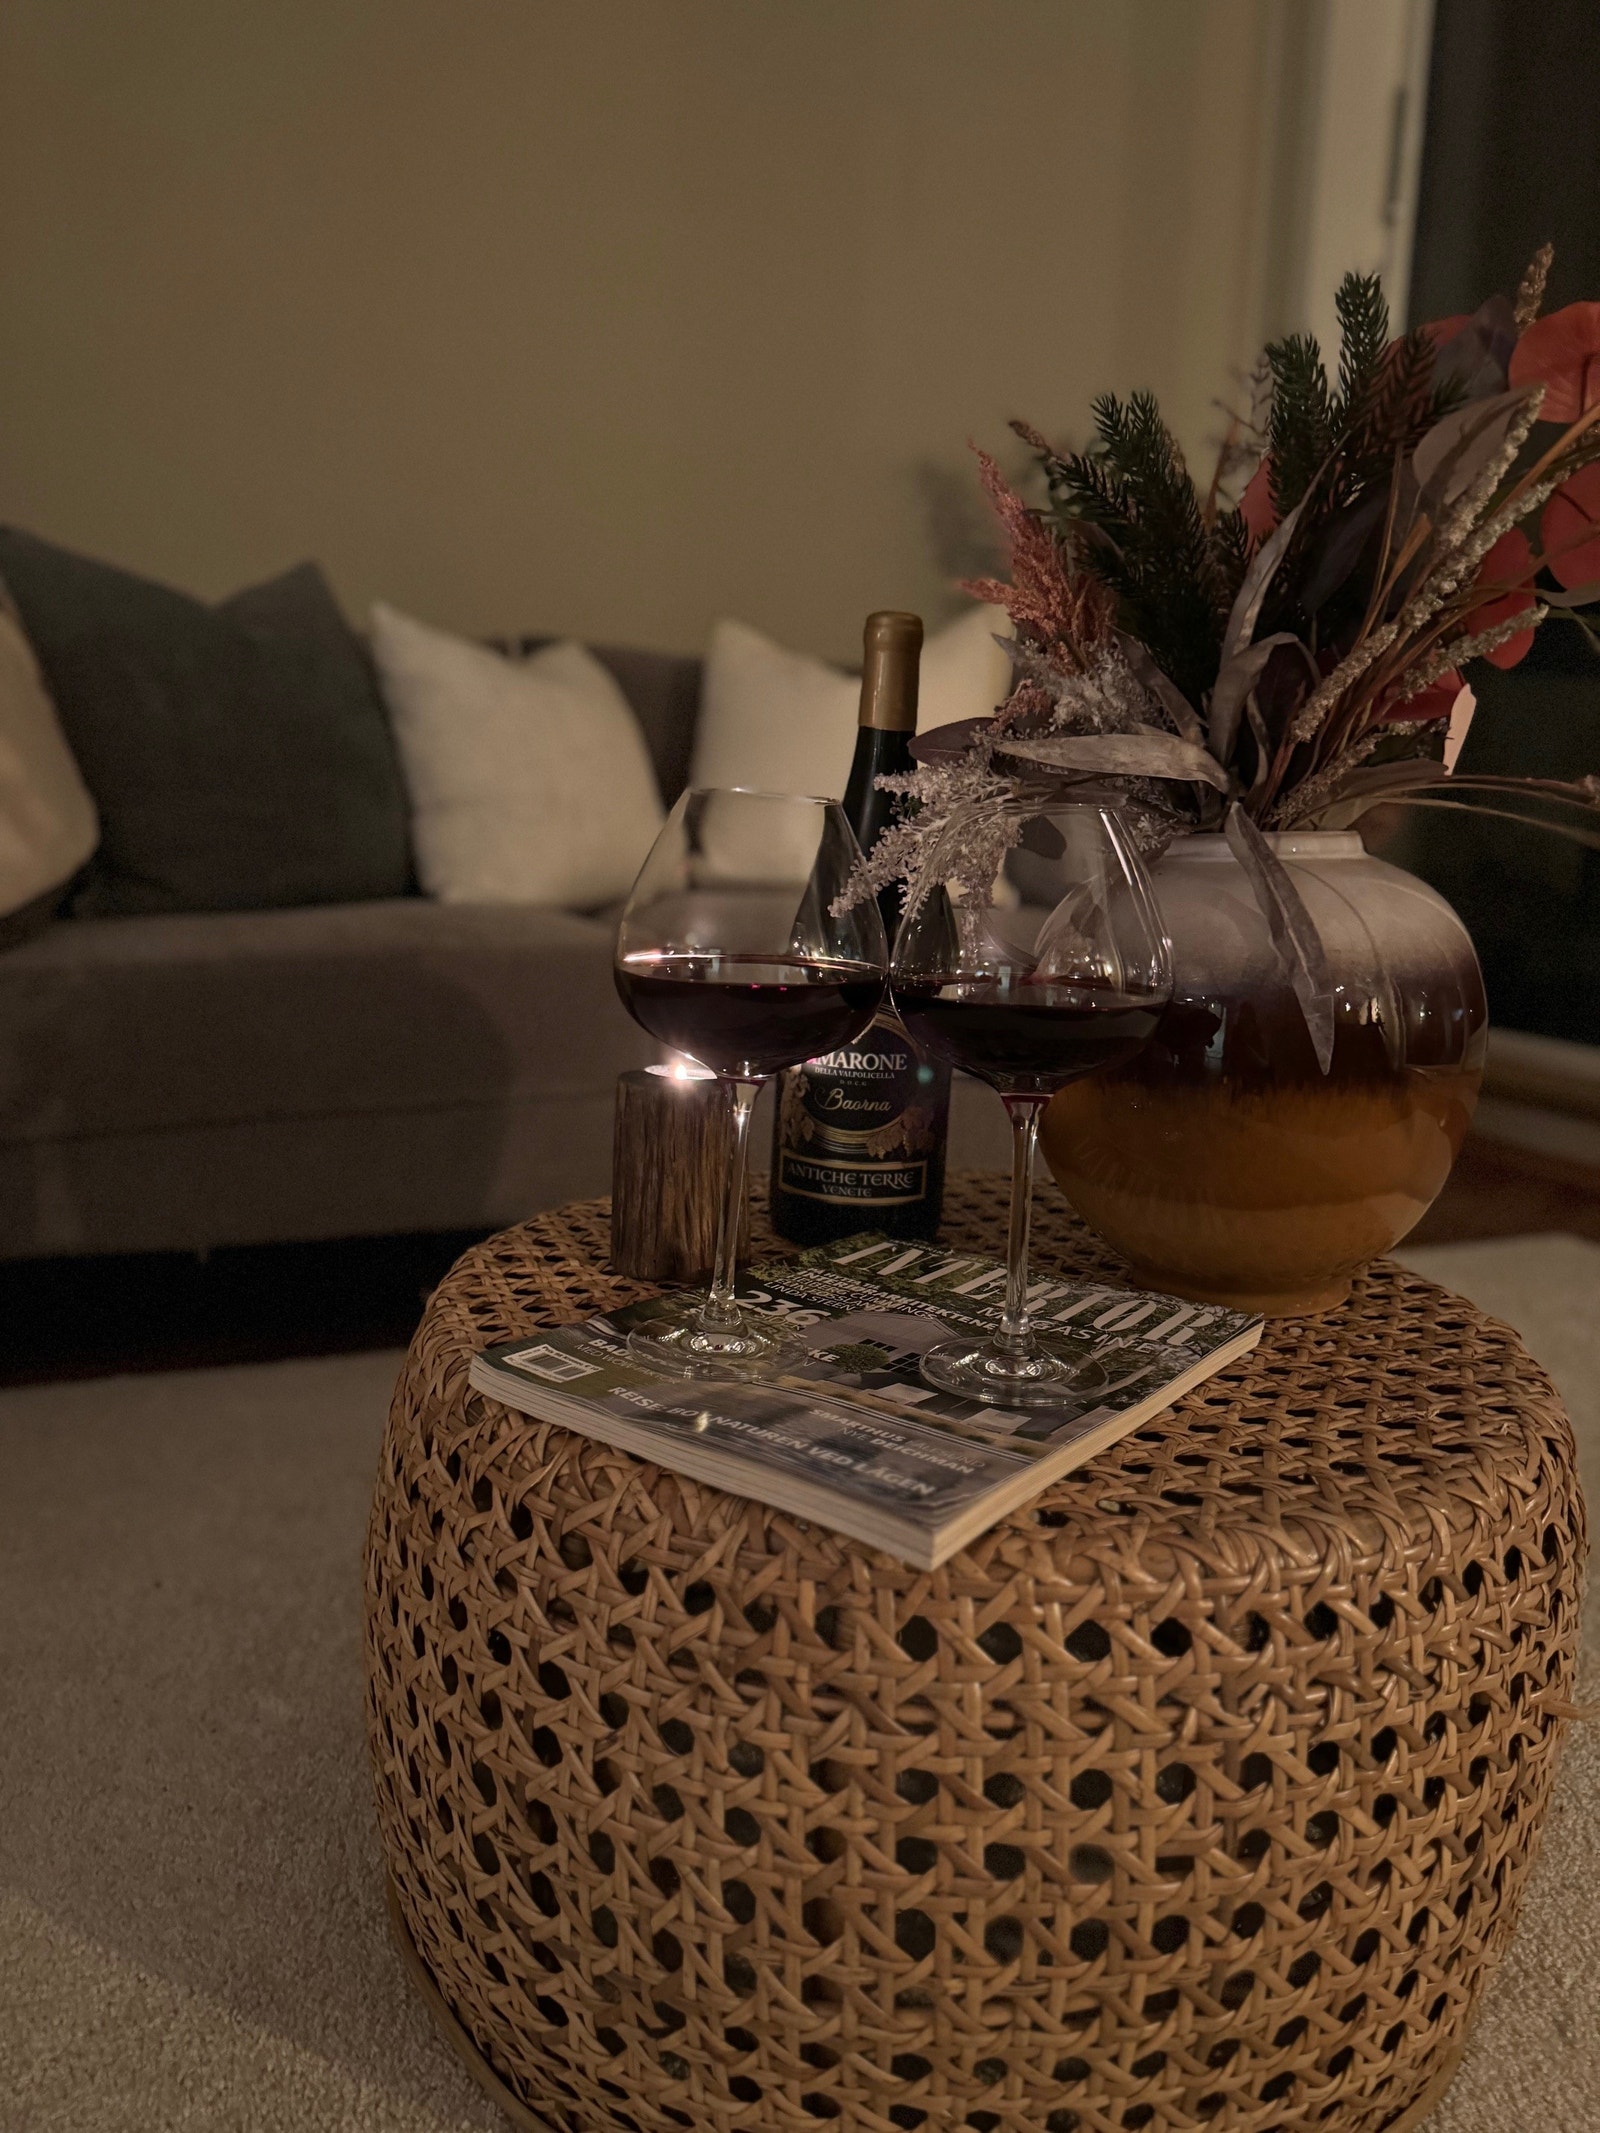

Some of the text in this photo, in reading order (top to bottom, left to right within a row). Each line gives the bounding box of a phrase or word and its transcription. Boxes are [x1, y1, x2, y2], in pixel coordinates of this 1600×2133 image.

[815, 1067, 895, 1079] DELLA VALPOLICELLA
[788, 1162, 914, 1190] ANTICHE TERRE
[822, 1184, 872, 1198] VENETE
[735, 1289, 832, 1326] 236
[763, 1282, 856, 1311] LINDA STEEN
[976, 1305, 1178, 1357] MGASINET
[709, 1416, 807, 1449] NATUREN
[806, 1445, 854, 1467] VED
[809, 1408, 905, 1443] SMARTHUS
[838, 1426, 975, 1474] NYE DEICHMAN
